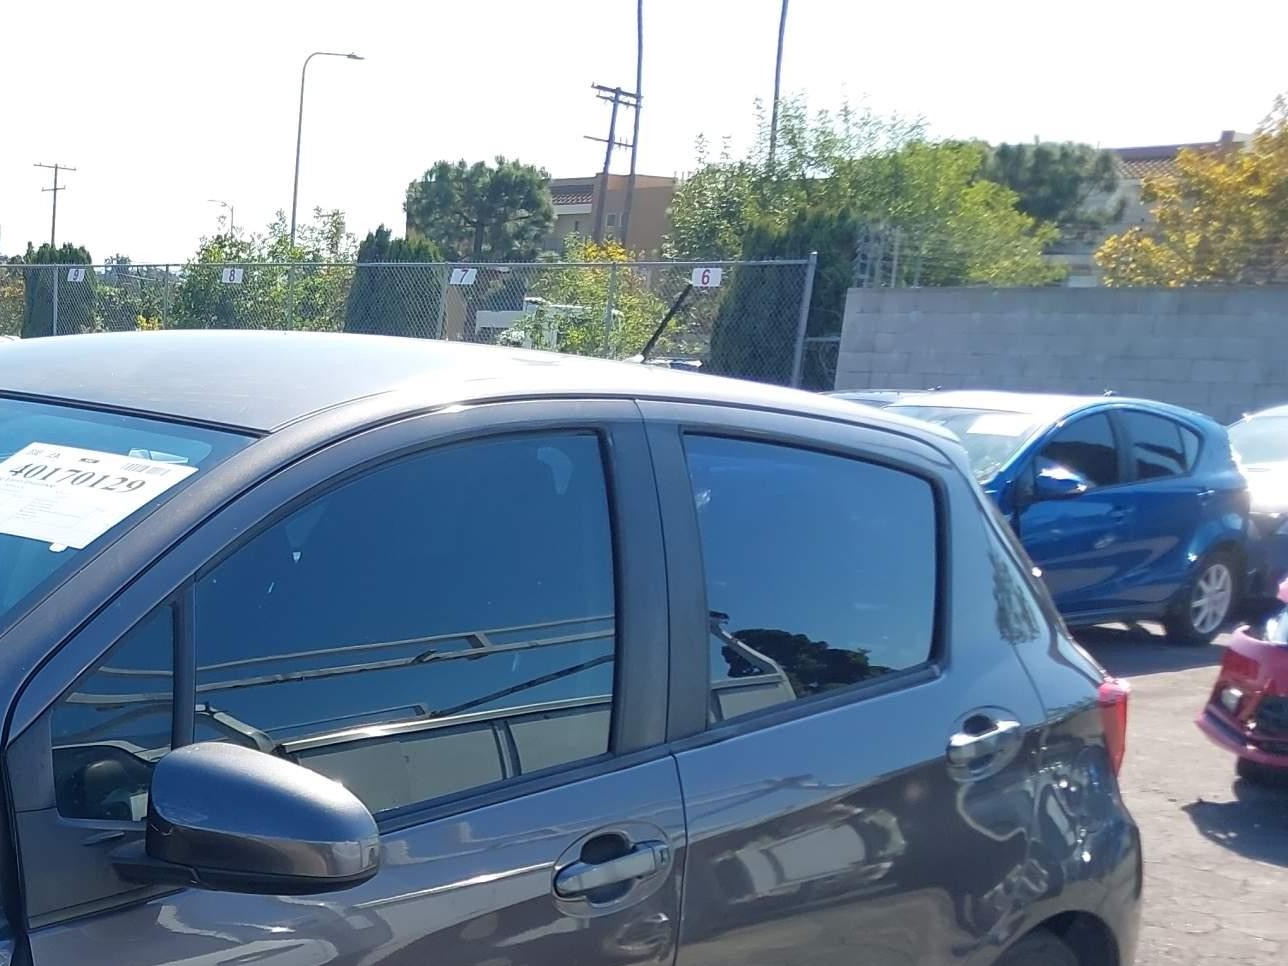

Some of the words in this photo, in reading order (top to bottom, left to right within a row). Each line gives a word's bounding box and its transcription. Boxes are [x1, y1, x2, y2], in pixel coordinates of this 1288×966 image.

[228, 269, 236, 282] 8
[460, 269, 470, 284] 7
[701, 269, 712, 286] 6
[9, 463, 147, 494] 40170129
